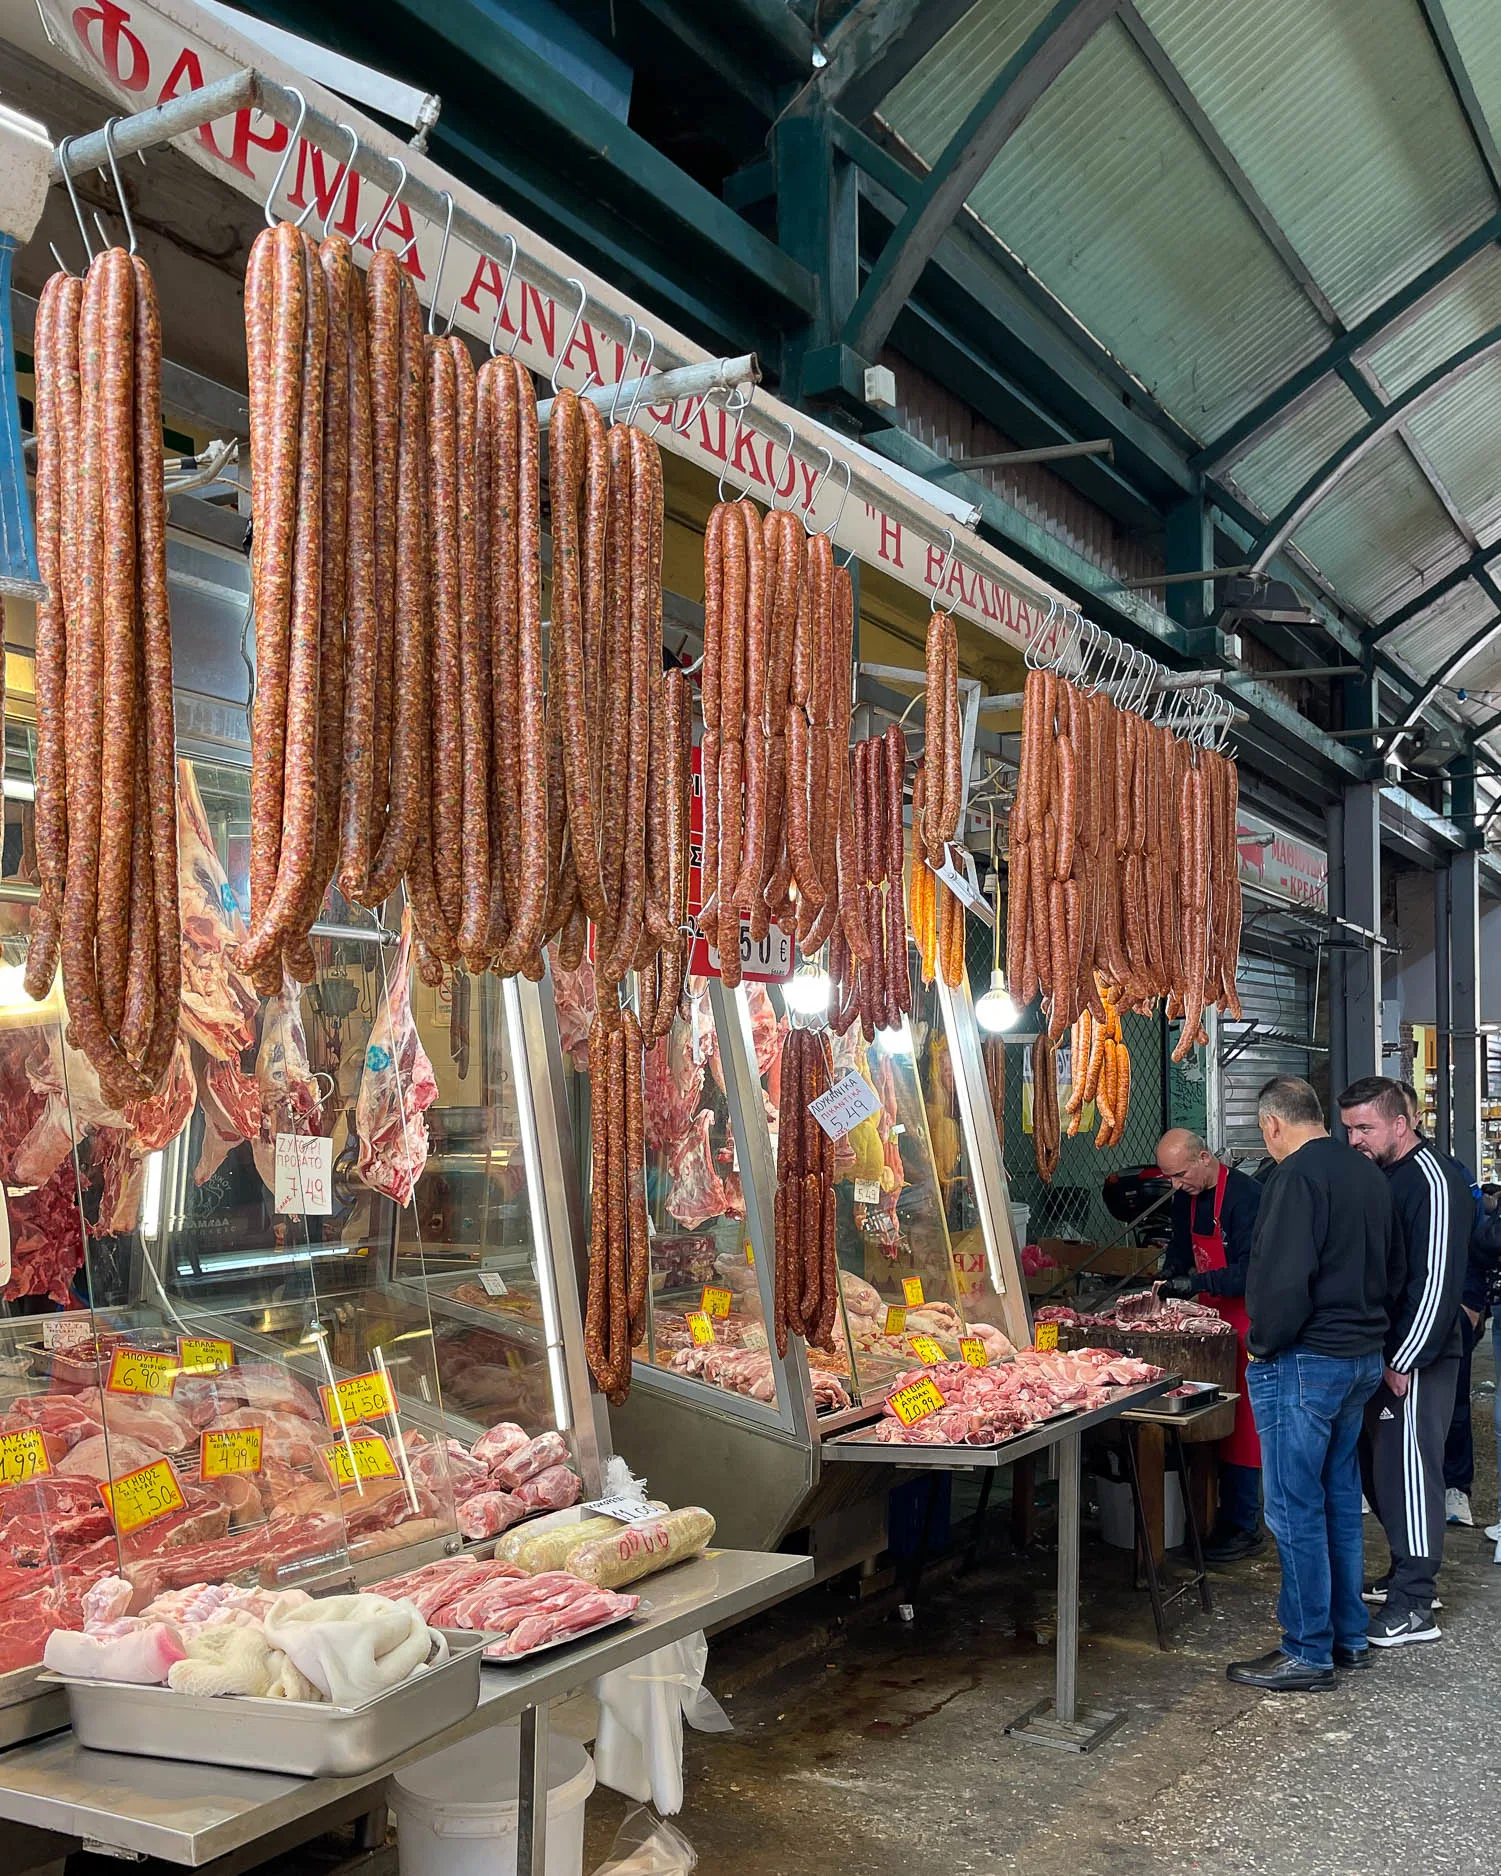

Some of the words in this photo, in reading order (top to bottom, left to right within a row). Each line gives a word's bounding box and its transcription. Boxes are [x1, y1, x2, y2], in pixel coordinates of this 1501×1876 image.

[811, 1078, 857, 1115] ΛΟΥΚΑΝΙΚΑ
[821, 1088, 861, 1119] ΠΙΚΑΝΤΙΚΑ
[122, 1351, 159, 1363] ΜΠΟΥΤΙ
[123, 1367, 160, 1391] 6,90
[901, 1389, 930, 1408] ΑΡΝΑΚΙ
[905, 1396, 936, 1423] 10,99
[207, 1431, 243, 1442] ΣΠΑΛΑ
[115, 1467, 161, 1494] ΣΤΗΘΟΣ
